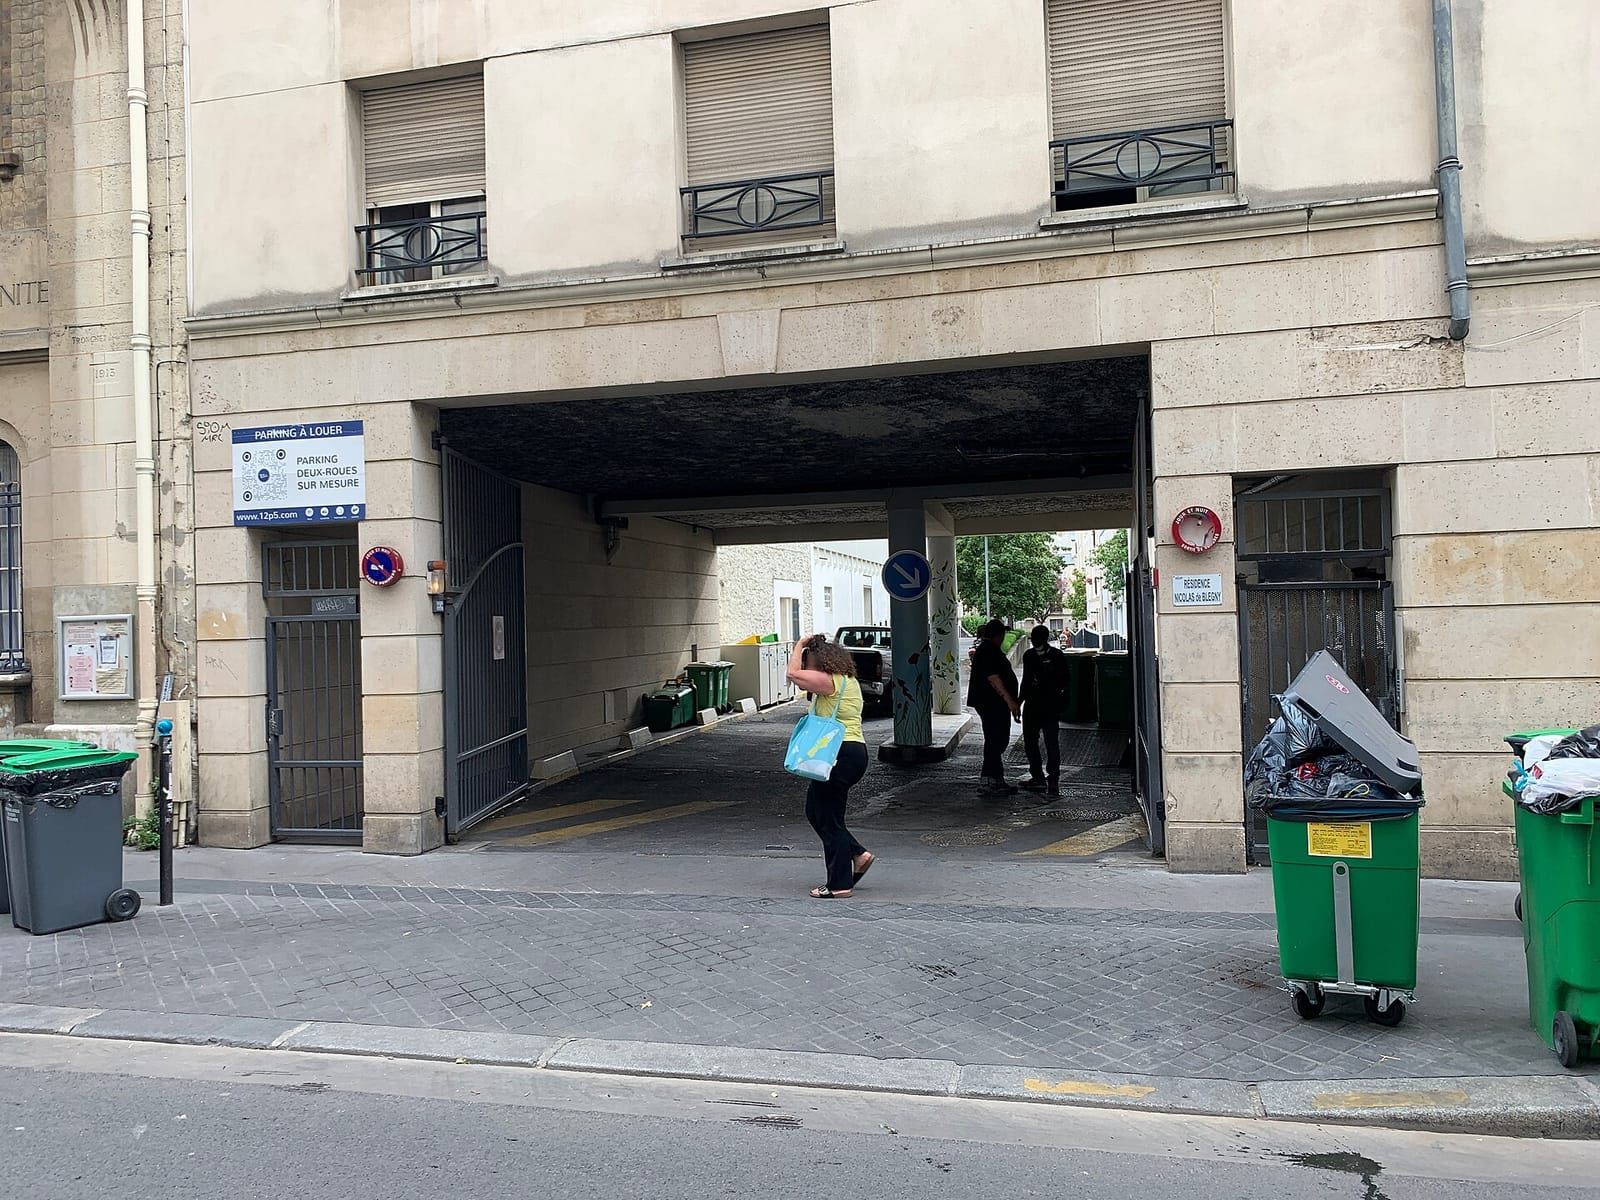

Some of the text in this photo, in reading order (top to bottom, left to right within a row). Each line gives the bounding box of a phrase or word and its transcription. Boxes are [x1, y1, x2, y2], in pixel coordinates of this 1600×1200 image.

[254, 425, 343, 440] PARKING À LOUER
[296, 455, 338, 466] PARKING
[296, 466, 358, 478] DEUX-ROUES
[297, 478, 360, 490] SUR MESURE
[236, 511, 298, 521] www.12p5.com
[1175, 507, 1209, 525] JOUR ET NUIT
[1174, 591, 1221, 603] NICOLAS de BLEGNY
